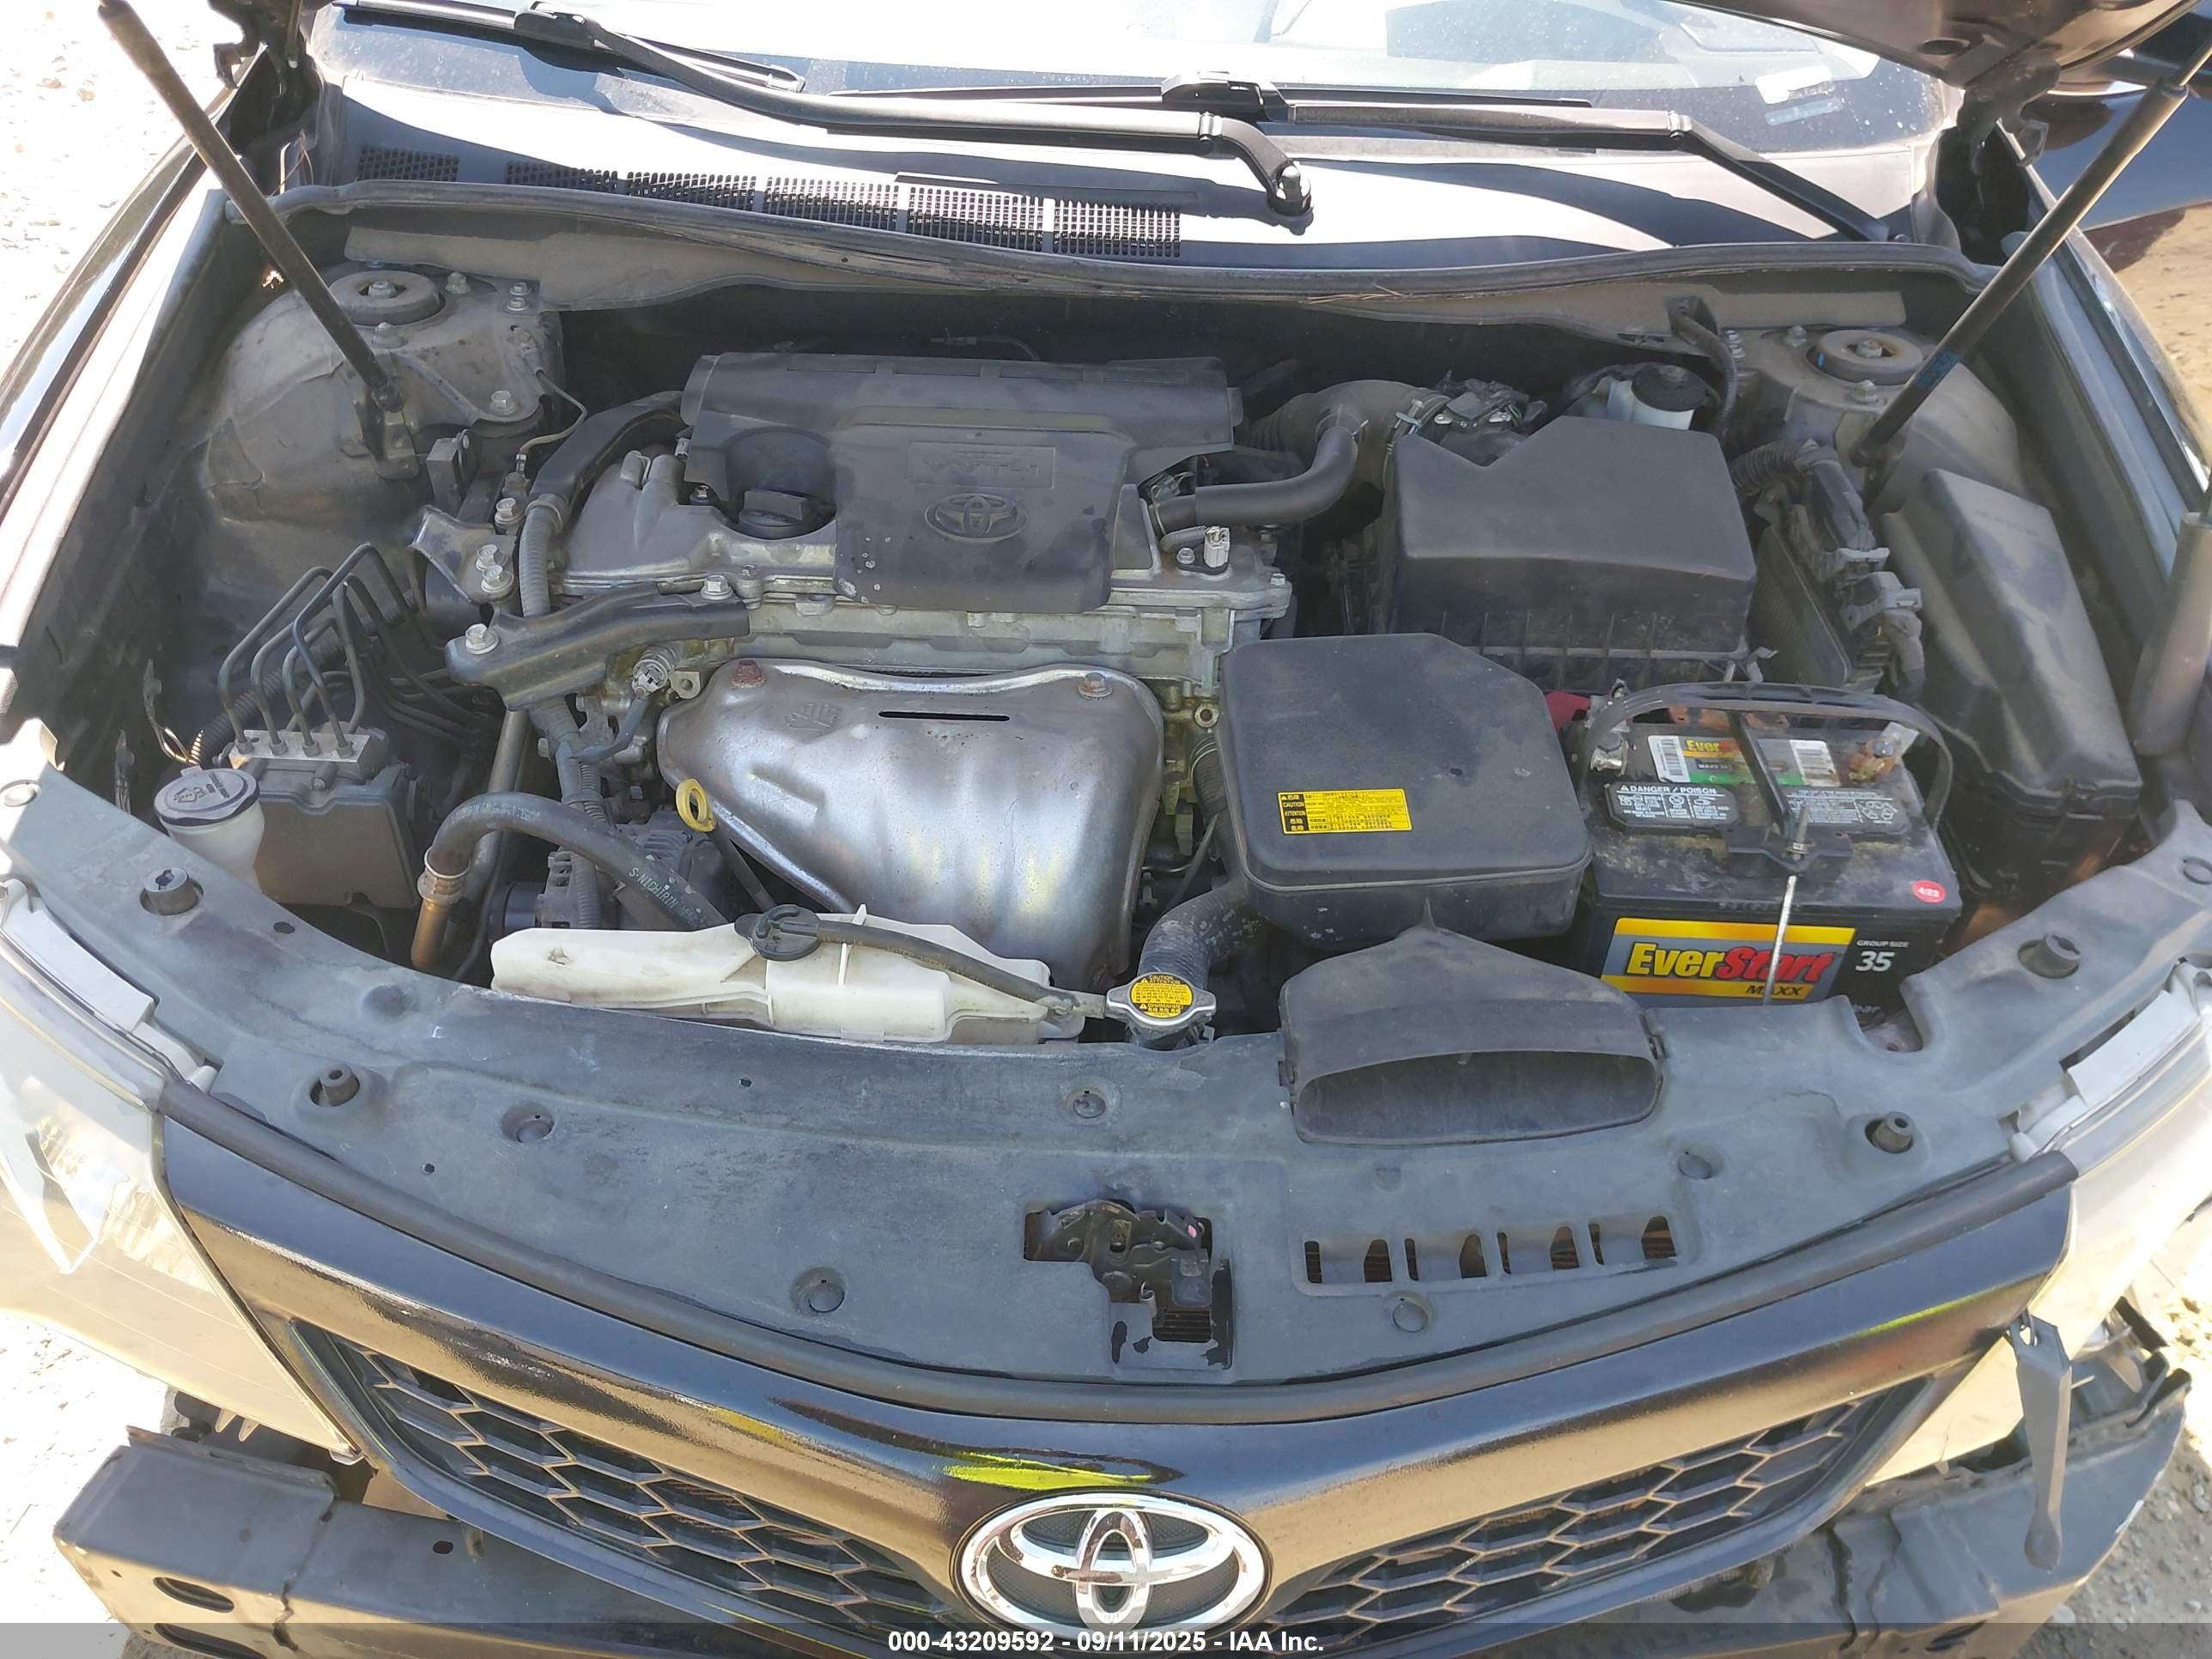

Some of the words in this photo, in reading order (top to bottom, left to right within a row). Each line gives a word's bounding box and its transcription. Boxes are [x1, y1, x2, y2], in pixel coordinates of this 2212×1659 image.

[1626, 941, 1835, 982] EverStart
[1855, 950, 1896, 972] 35
[1746, 984, 1802, 996] MXX
